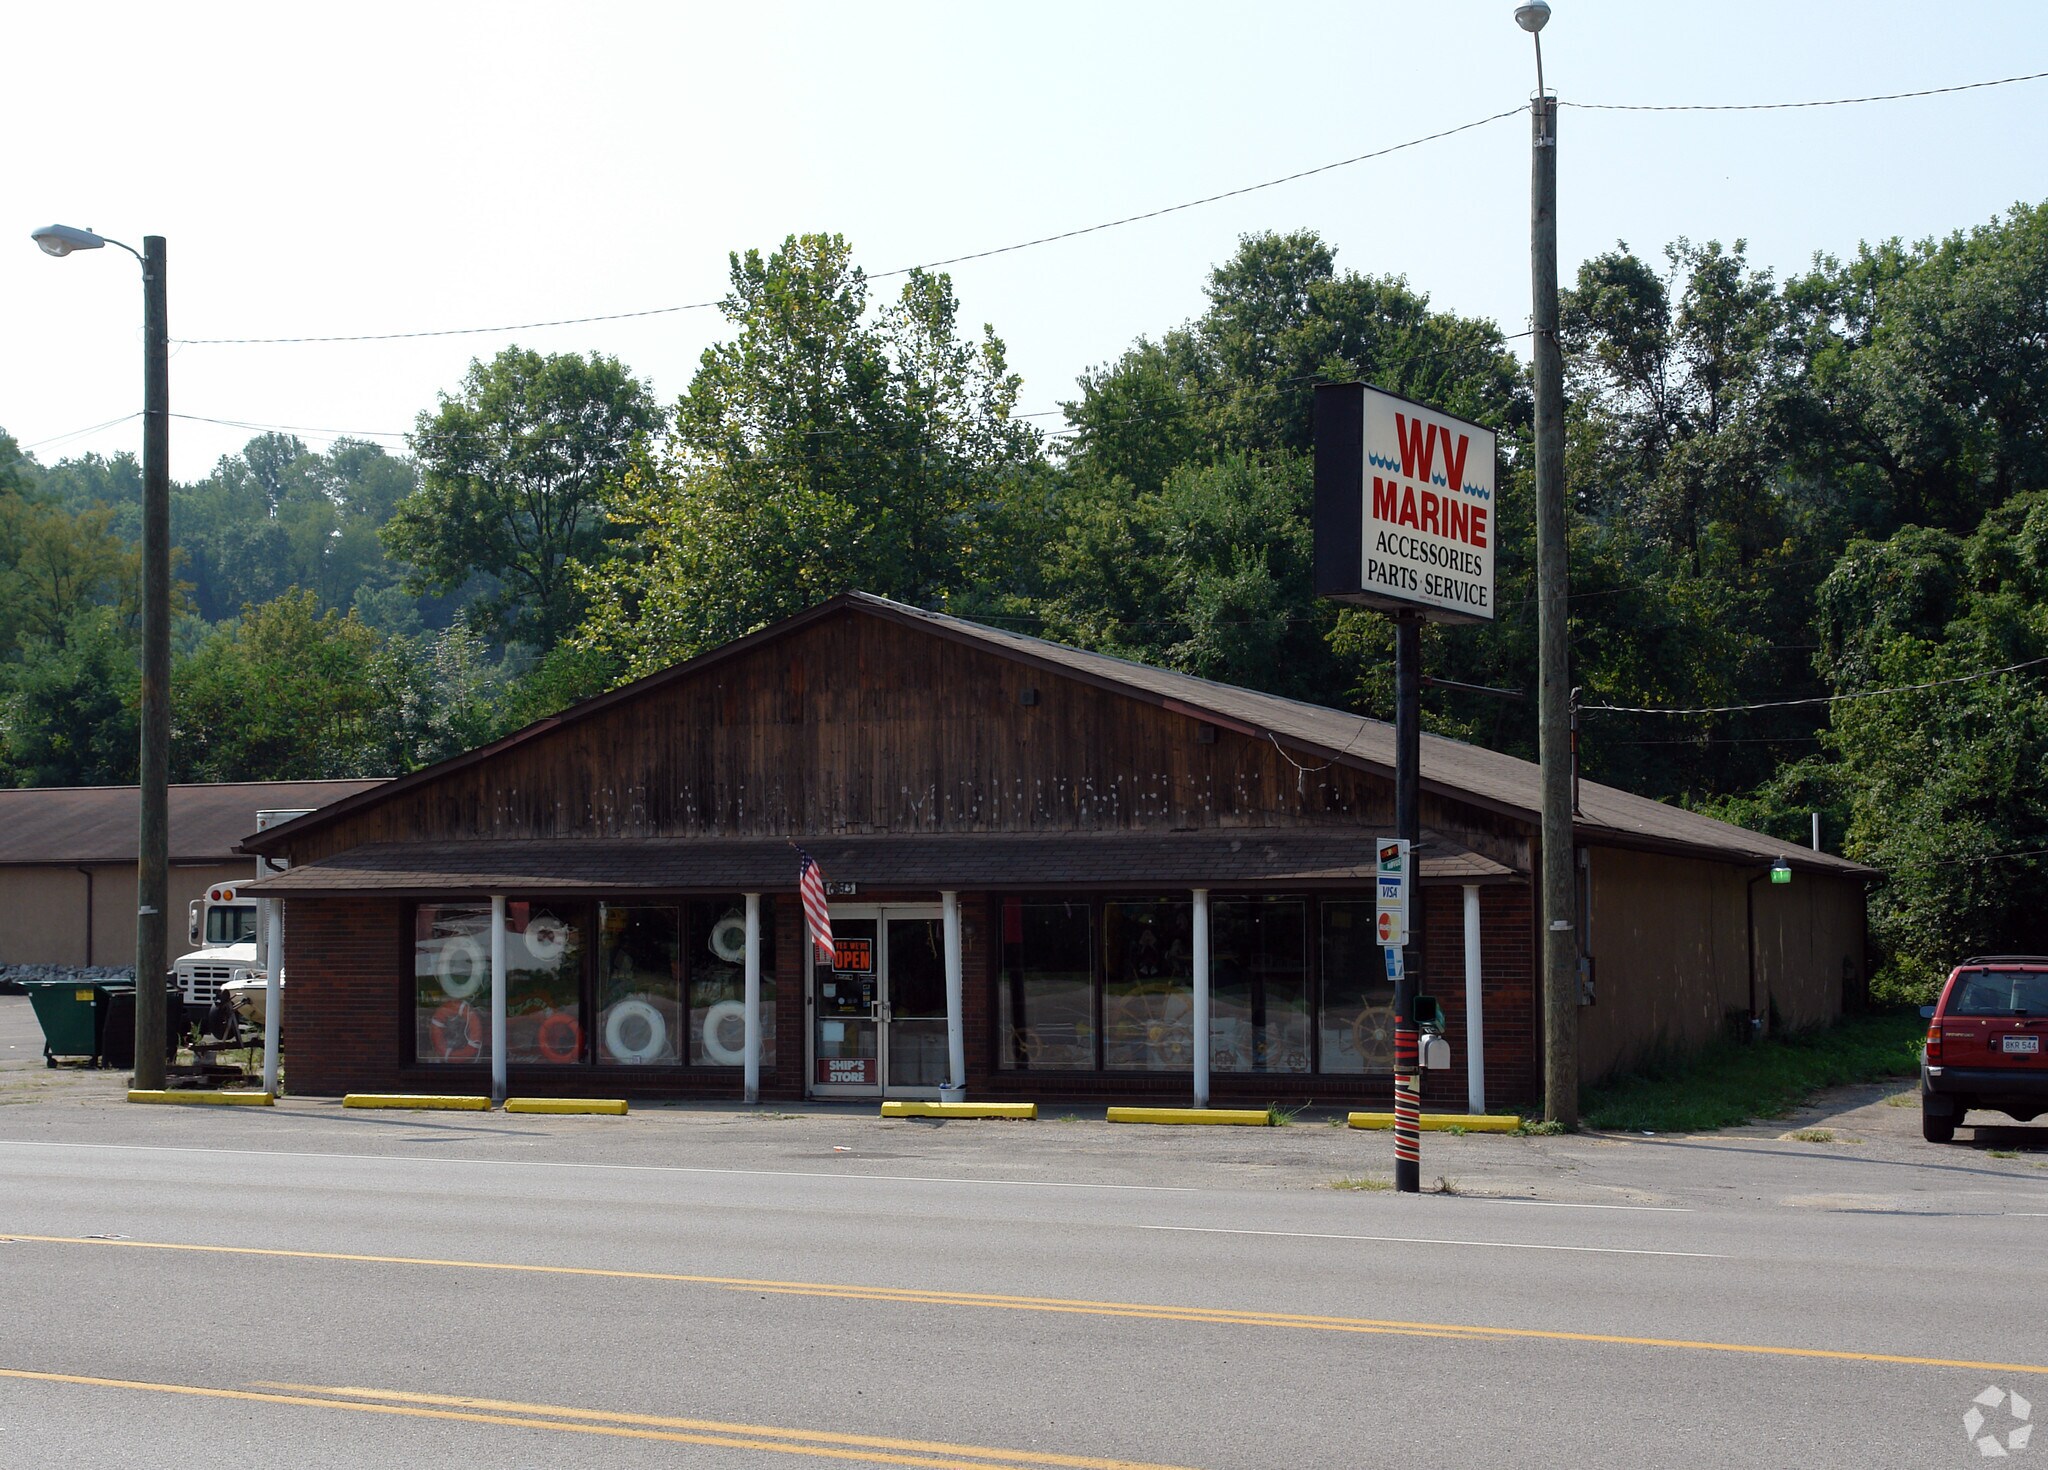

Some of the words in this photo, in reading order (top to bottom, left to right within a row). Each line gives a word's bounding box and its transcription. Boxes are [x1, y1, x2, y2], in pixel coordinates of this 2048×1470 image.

[1395, 412, 1469, 492] WV
[1373, 476, 1487, 548] MARINE
[1376, 531, 1482, 577] ACCESSORIES
[1368, 559, 1418, 591] PARTS
[1425, 573, 1488, 607] SERVICE
[1382, 886, 1398, 898] VISA
[834, 950, 870, 969] OPEN
[829, 1060, 865, 1071] SHIP'S
[829, 1072, 865, 1083] STORE
